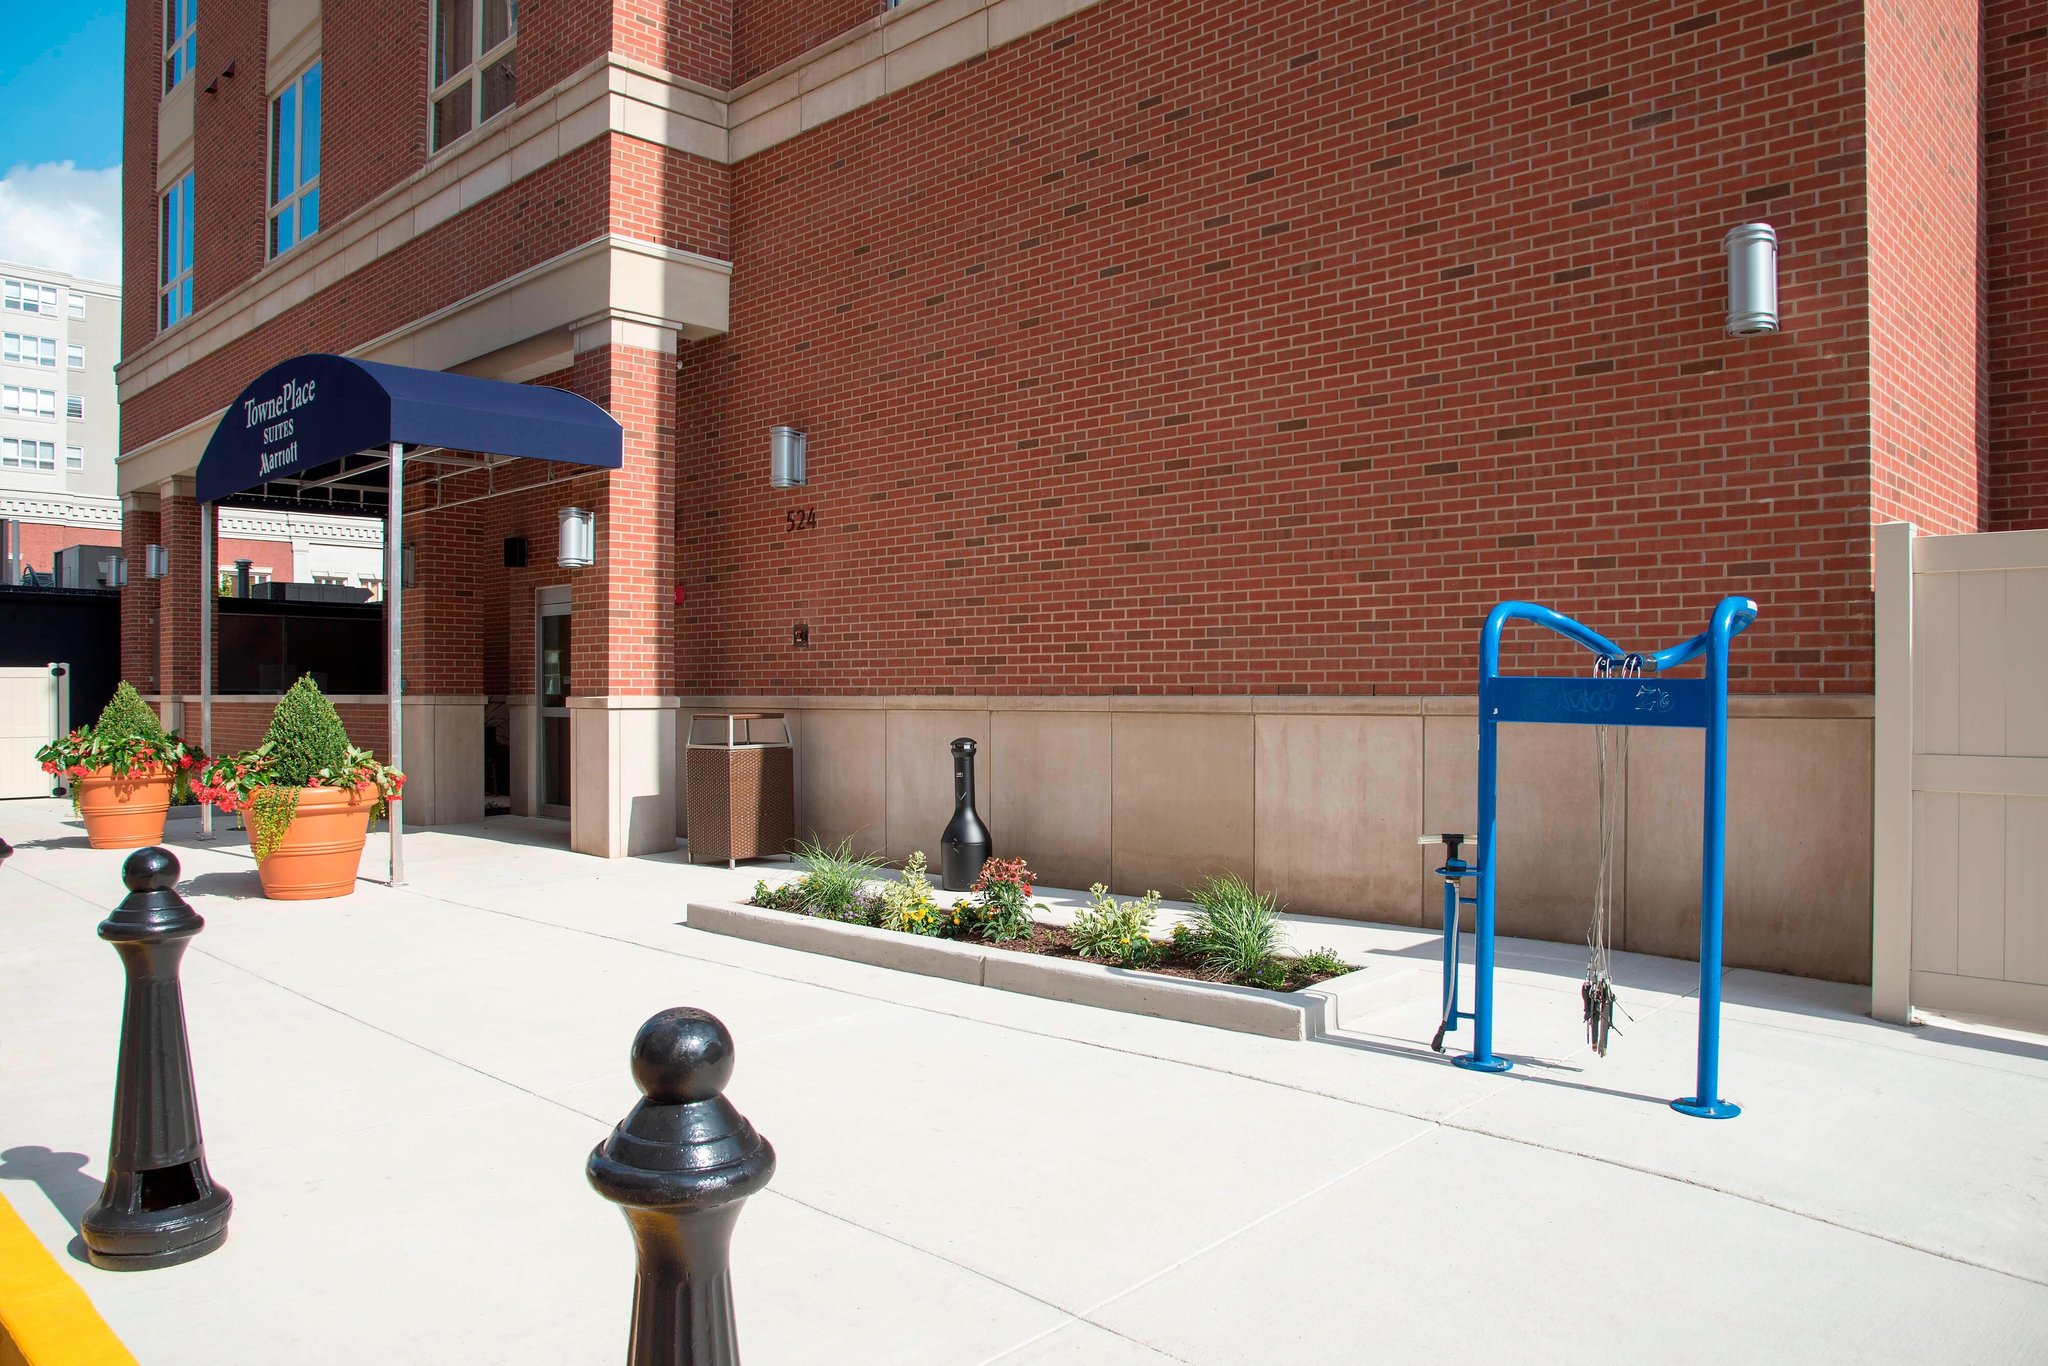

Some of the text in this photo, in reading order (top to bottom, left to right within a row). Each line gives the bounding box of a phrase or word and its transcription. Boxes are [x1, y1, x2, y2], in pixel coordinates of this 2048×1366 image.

[244, 378, 316, 428] TownePlace
[263, 418, 294, 445] SUITES
[259, 440, 298, 477] Marriott
[786, 507, 817, 532] 524
